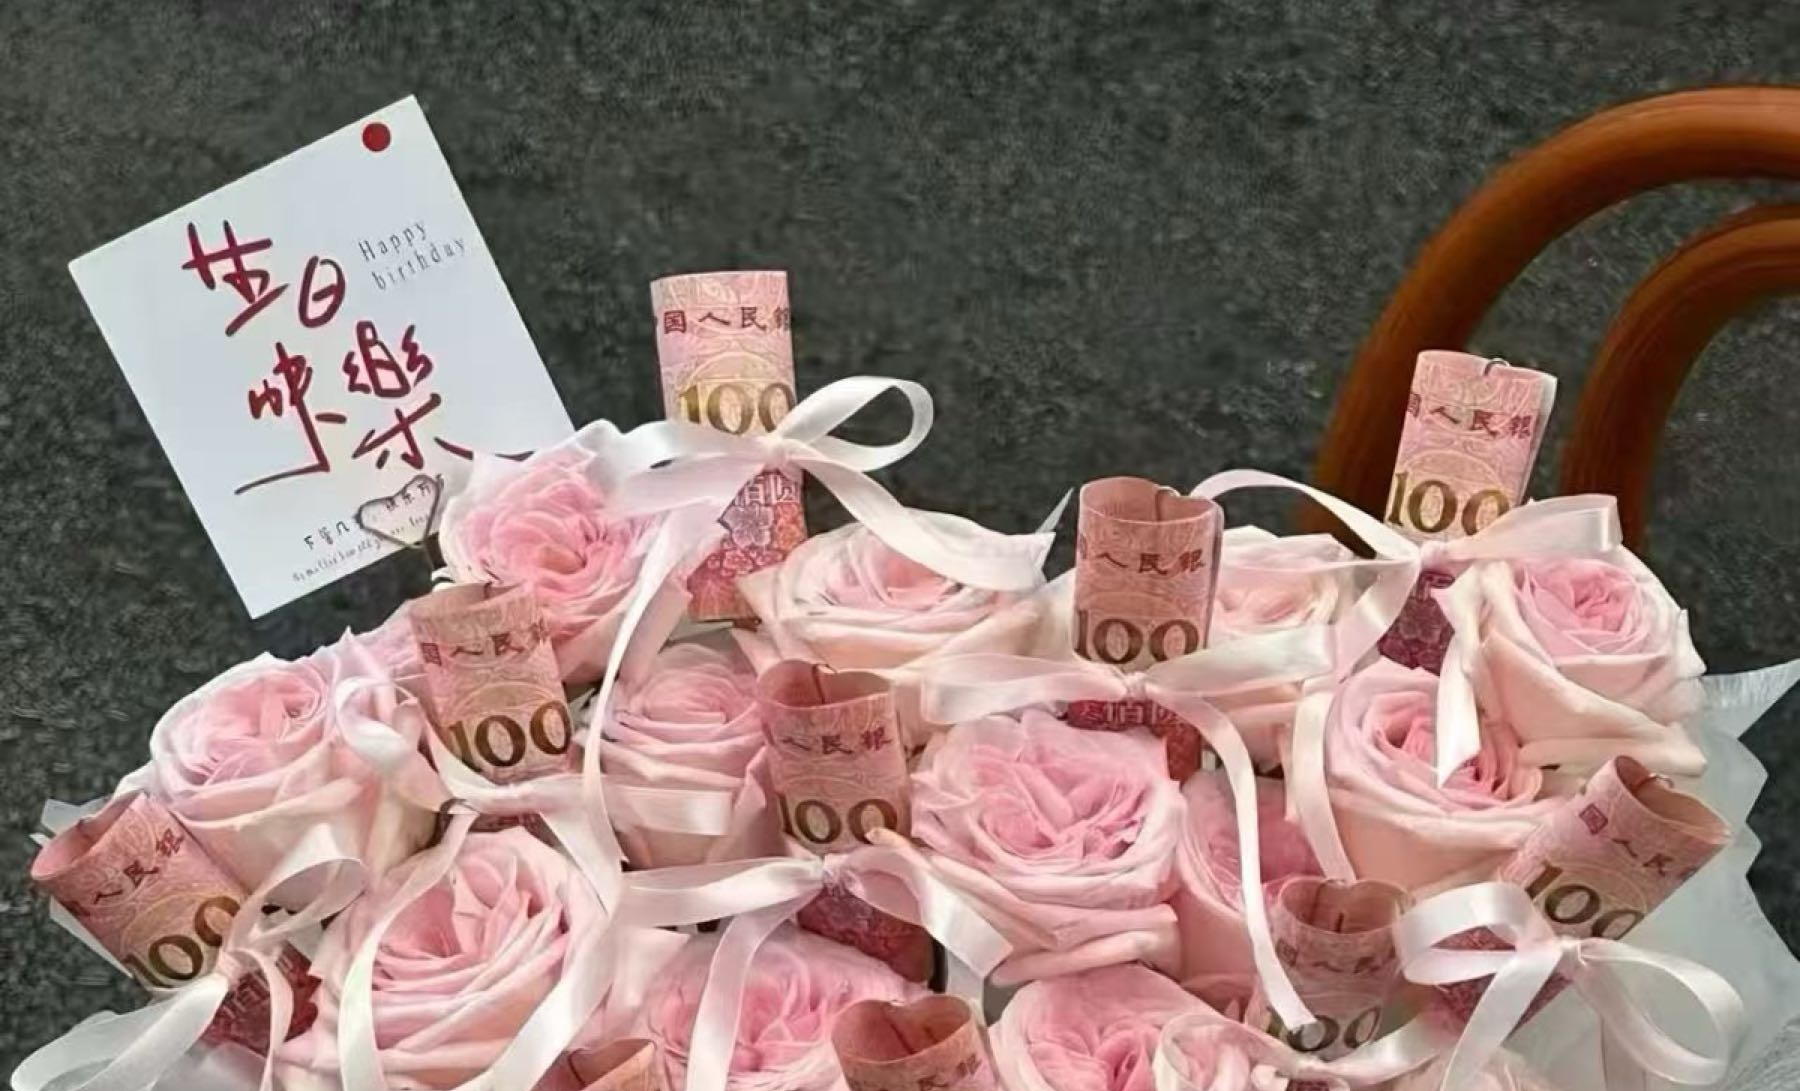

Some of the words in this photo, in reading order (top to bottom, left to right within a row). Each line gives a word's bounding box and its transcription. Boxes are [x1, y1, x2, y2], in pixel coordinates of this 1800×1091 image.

[359, 221, 427, 261] Happy
[372, 238, 466, 290] birthday
[676, 382, 796, 436] 100
[1387, 471, 1510, 536] 100
[1074, 609, 1200, 665] 100
[449, 699, 572, 773] 100
[776, 791, 898, 845] 100
[1525, 860, 1645, 940] 100
[123, 896, 241, 989] 100
